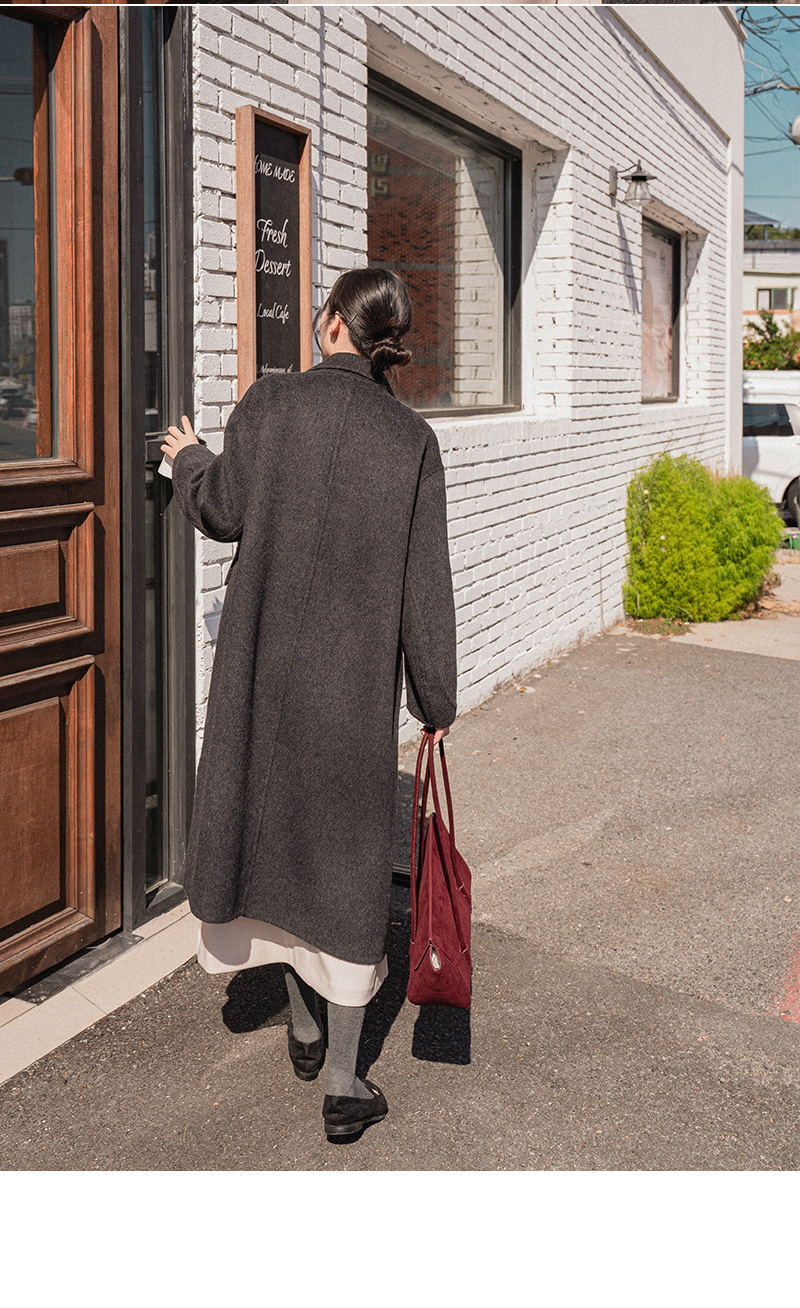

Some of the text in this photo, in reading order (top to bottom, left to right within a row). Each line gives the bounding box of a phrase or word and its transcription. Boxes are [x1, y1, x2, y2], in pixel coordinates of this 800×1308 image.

[273, 166, 296, 183] MADE
[257, 218, 288, 248] Fresh
[255, 248, 291, 277] Dessert
[257, 302, 277, 319] Local
